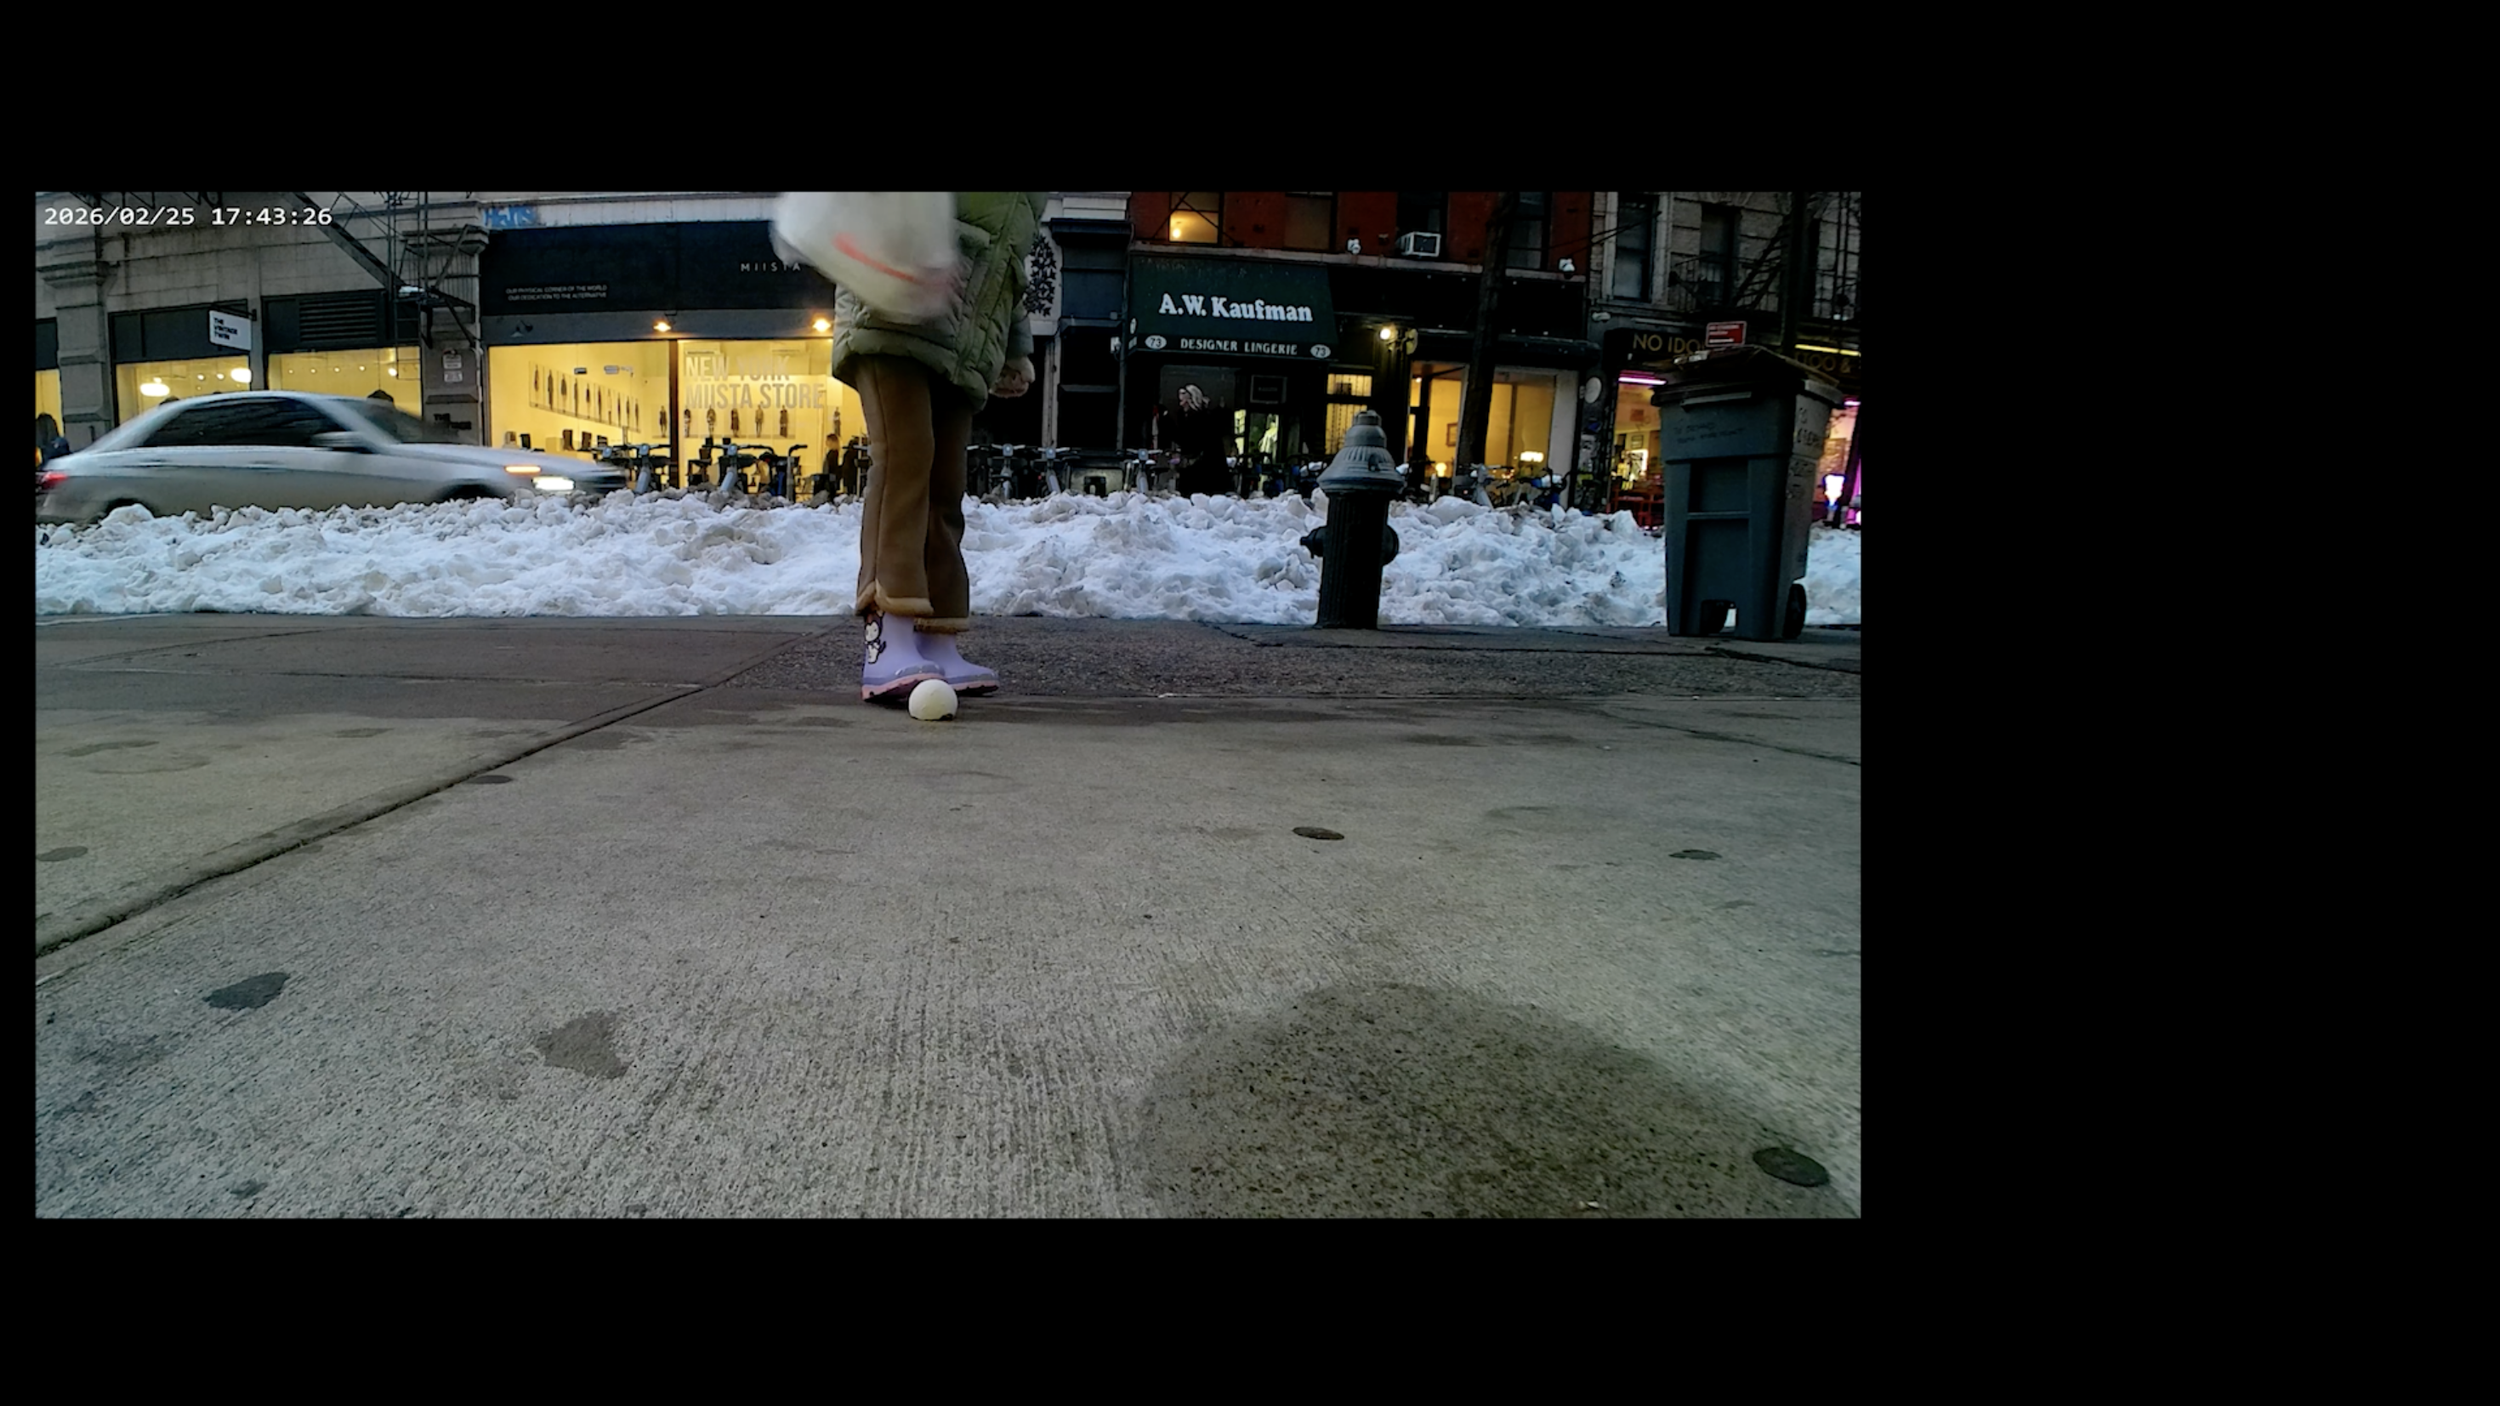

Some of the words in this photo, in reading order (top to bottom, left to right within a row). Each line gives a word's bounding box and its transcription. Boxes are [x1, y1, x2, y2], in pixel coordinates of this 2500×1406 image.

[1158, 293, 1207, 317] A.W.
[1211, 296, 1313, 322] Kaufman
[1149, 336, 1163, 348] 73
[1180, 338, 1238, 352] DESIGNER
[1244, 341, 1298, 356] LINGERIE
[1314, 346, 1327, 357] 73
[1633, 333, 1663, 352] NO
[685, 356, 730, 381] NEW
[737, 356, 790, 381] YORK
[760, 383, 824, 410] STORE
